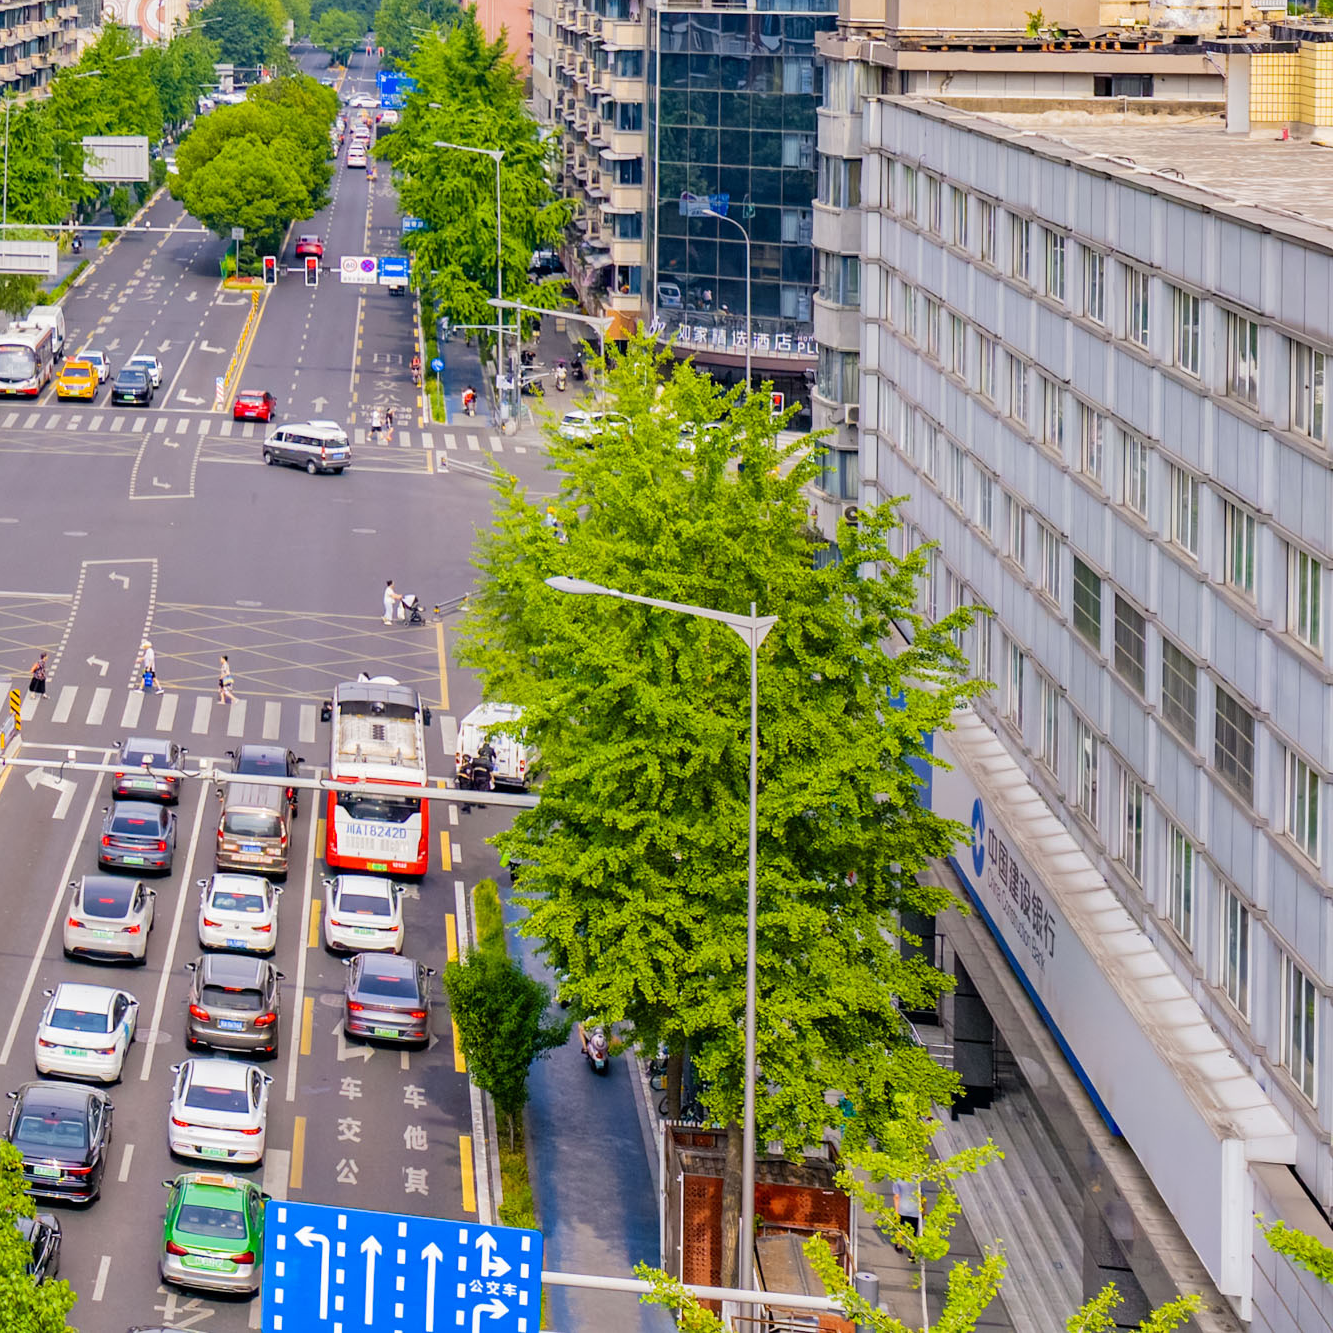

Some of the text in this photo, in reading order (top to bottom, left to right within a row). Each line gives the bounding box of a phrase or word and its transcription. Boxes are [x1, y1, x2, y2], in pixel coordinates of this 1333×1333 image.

[988, 827, 1057, 959] 中国建设银行
[468, 1279, 518, 1297] 公交车
